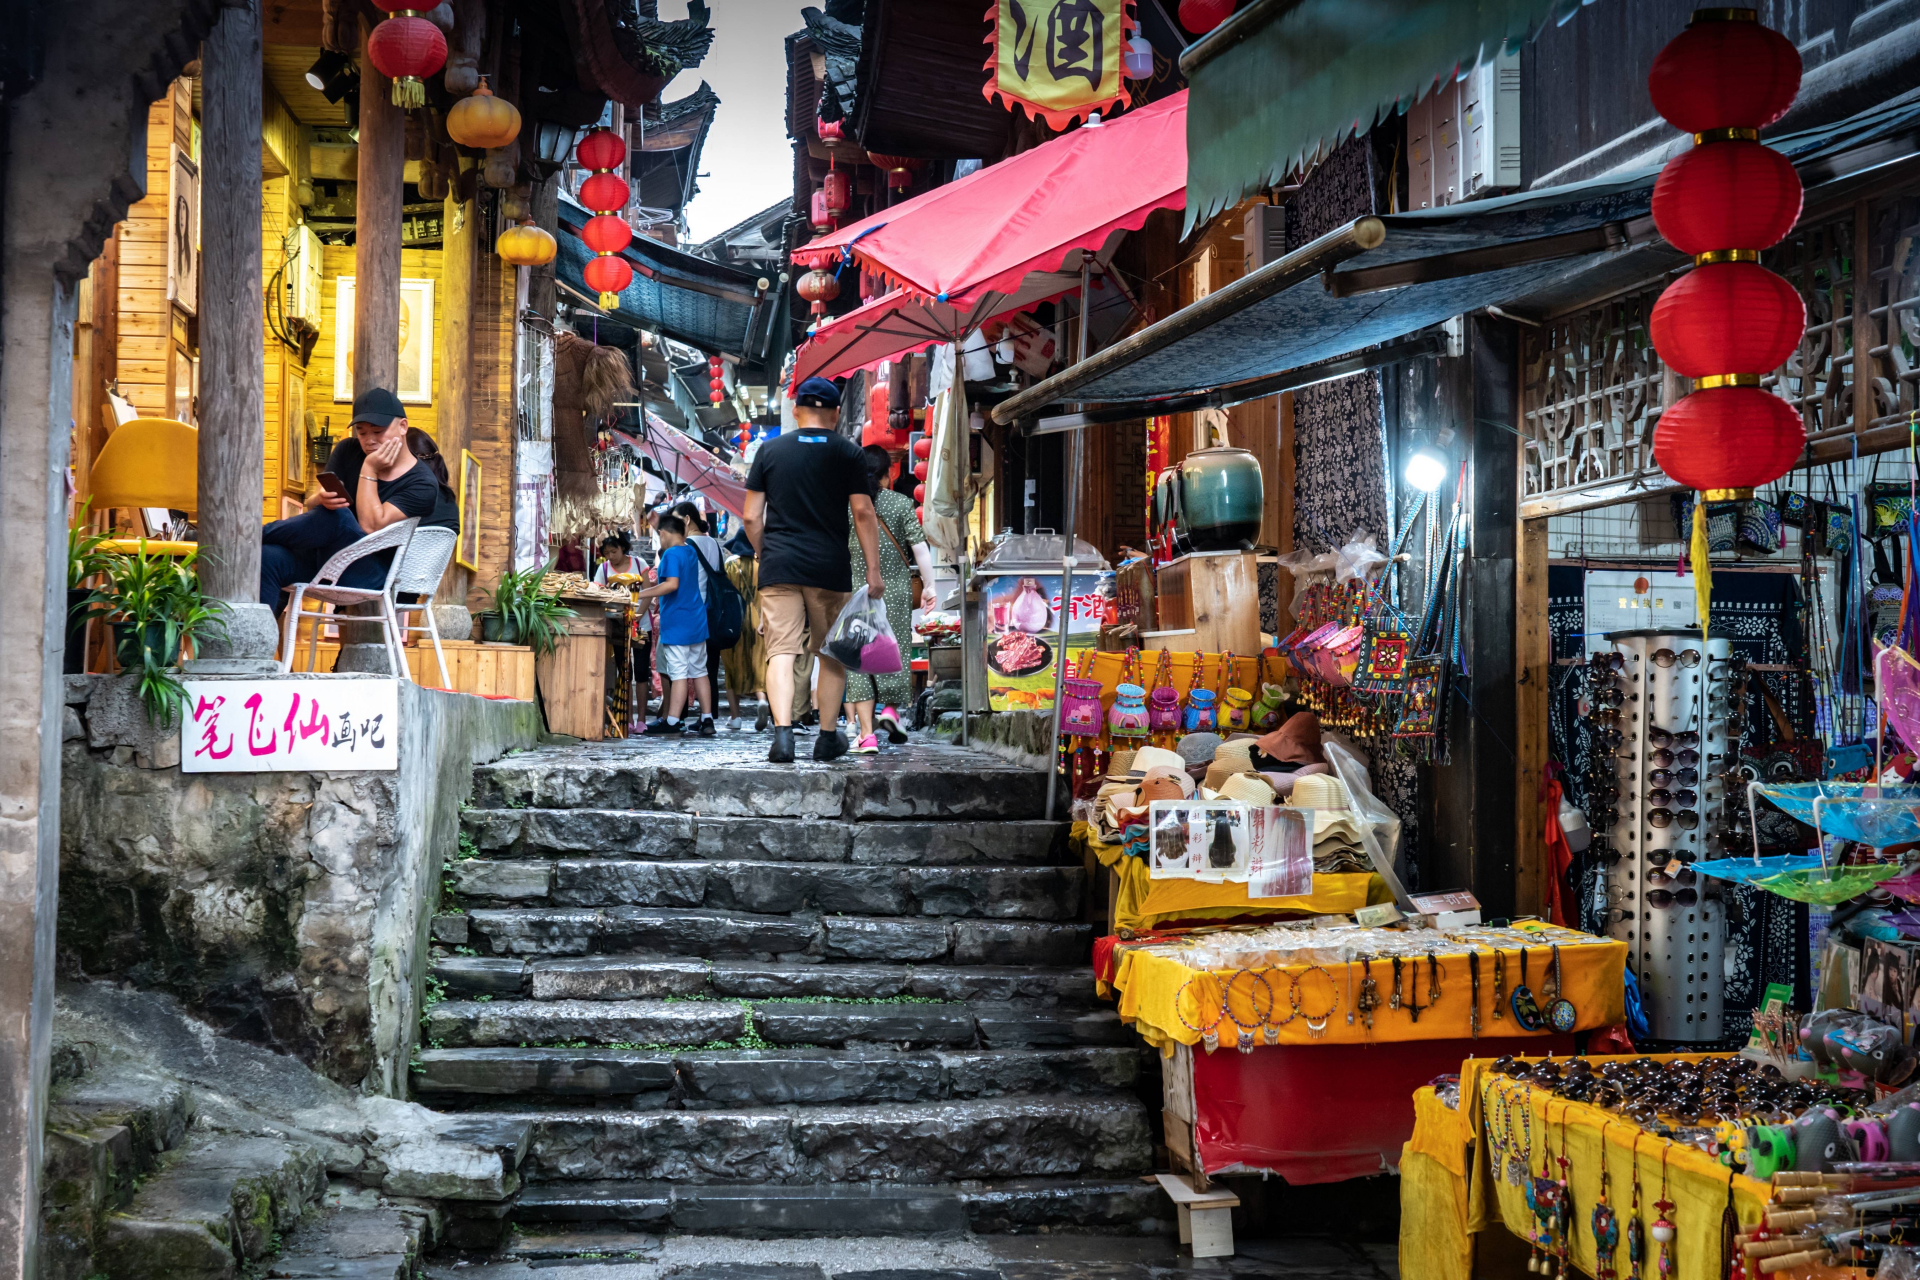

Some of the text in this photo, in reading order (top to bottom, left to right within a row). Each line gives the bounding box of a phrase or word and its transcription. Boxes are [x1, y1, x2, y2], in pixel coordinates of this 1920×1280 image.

[1010, 0, 1105, 92] 酒
[1416, 892, 1472, 910] 假一罚十
